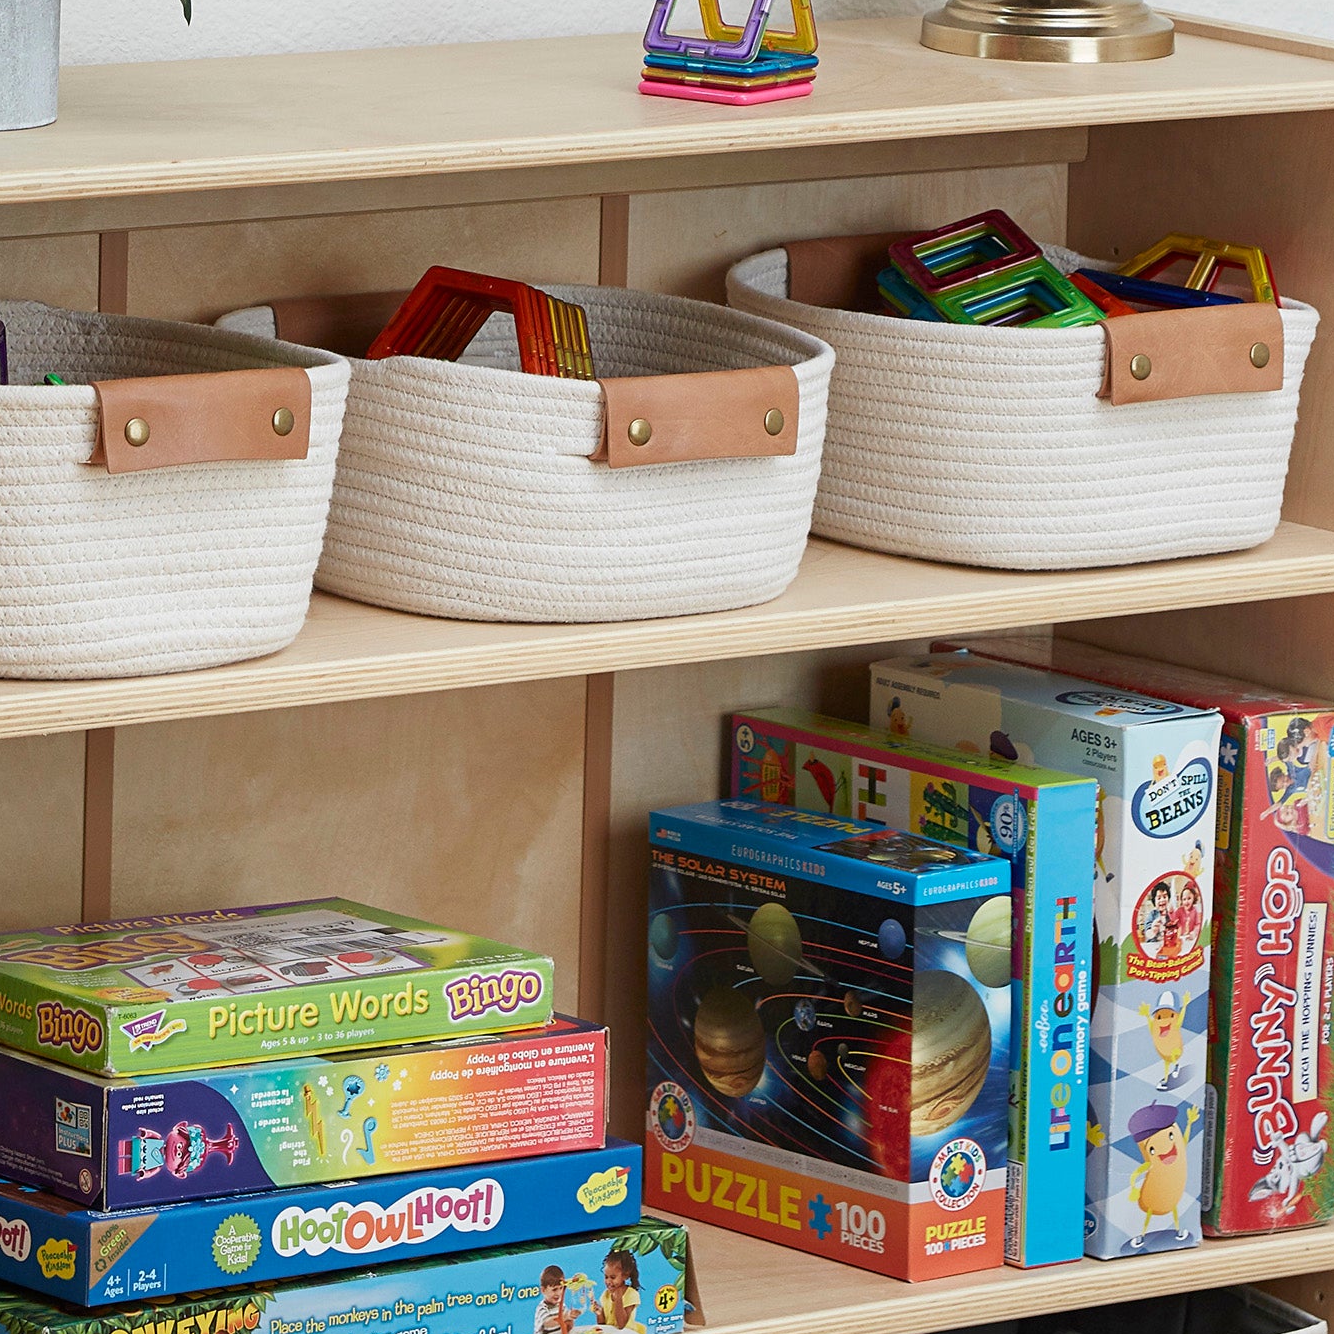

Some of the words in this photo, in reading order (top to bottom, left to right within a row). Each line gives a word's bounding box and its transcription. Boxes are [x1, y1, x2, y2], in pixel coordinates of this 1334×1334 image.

[740, 730, 751, 750] 5+
[1071, 728, 1101, 746] AGES
[1104, 736, 1117, 749] 3+
[1086, 748, 1091, 756] 2
[1092, 749, 1117, 762] Players
[1149, 778, 1177, 802] DON'T
[1181, 774, 1208, 786] SPILL
[1178, 788, 1191, 797] THE
[1145, 789, 1204, 831] BEANS
[1221, 787, 1230, 833] Insights
[1028, 807, 1036, 830] Erde
[652, 849, 674, 865] THE
[677, 856, 725, 878] SOLAR
[729, 868, 786, 892] SYSTEM
[877, 880, 892, 890] AGES
[892, 881, 907, 895] 5+
[1257, 846, 1299, 956] HOP
[54, 919, 152, 936] Picture
[153, 911, 244, 927] Words
[858, 939, 878, 949] NEPTUNE
[1305, 910, 1318, 968] BUNNIES!
[1128, 955, 1144, 967] The
[1146, 948, 1203, 969] Bean-Balancing
[210, 965, 247, 974] bicycle
[1129, 967, 1180, 980] Pot-Tipping
[1324, 956, 1334, 992] PLAYERS
[447, 972, 540, 1017] Bingo
[1077, 969, 1089, 1011] game
[1302, 971, 1312, 1026] HOPPING
[209, 1002, 320, 1040] Picture
[330, 981, 429, 1025] Words
[1323, 992, 1332, 1021] 2-4
[862, 1010, 878, 1019] MARS
[37, 1002, 102, 1052] Bingo
[816, 1020, 834, 1028] EARTH
[260, 1039, 281, 1050] Ages
[282, 1037, 288, 1046] 5
[289, 1036, 296, 1045] &
[297, 1037, 309, 1048] up
[317, 1033, 323, 1042] 3
[324, 1032, 333, 1041] to
[335, 1030, 346, 1040] 36
[346, 1027, 375, 1040] players
[1301, 1028, 1310, 1053] THE
[1321, 1023, 1331, 1045] FOR
[541, 1048, 553, 1056] en
[554, 1042, 595, 1055] Aventura
[1075, 1015, 1089, 1075] memory
[466, 1053, 496, 1066] Poppy
[498, 1054, 510, 1064] de
[512, 1049, 539, 1060] Globo
[548, 1054, 594, 1066] L'aventure
[475, 1061, 533, 1075] montgolfière
[534, 1060, 546, 1069] en
[1247, 978, 1299, 1151] BUNNY
[430, 1070, 459, 1082] Poppy
[461, 1070, 474, 1079] de
[1301, 1056, 1310, 1093] CATCH
[251, 1090, 280, 1101] cuerda!
[282, 1089, 289, 1097] la
[527, 1091, 542, 1100] LEGO
[653, 1082, 676, 1104] SMART
[676, 1088, 692, 1114] KIDS
[251, 1095, 294, 1108] ¡Encuentra
[147, 1107, 164, 1115] actual
[514, 1107, 529, 1116] LEGO
[258, 1119, 280, 1127] corde
[271, 1125, 298, 1133] Trouve
[58, 1135, 77, 1149] PLUS
[653, 1122, 692, 1153] COLLECTION
[279, 1141, 305, 1151] string!
[293, 1149, 307, 1157] the
[292, 1157, 311, 1167] Find
[934, 1140, 965, 1170] SMART
[964, 1141, 984, 1164] KIDS
[582, 1177, 624, 1199] Peaceable
[934, 1182, 980, 1209] COLLECTION
[588, 1187, 622, 1208] Kingdom
[661, 1153, 802, 1231] PUZZLE
[835, 1201, 886, 1242] 100
[98, 1223, 120, 1246] 100%
[229, 1225, 236, 1236] A
[925, 1216, 987, 1243] PUZZLE
[99, 1229, 127, 1257] Green
[215, 1233, 259, 1247] Cooperative
[840, 1230, 885, 1255] PIECES
[924, 1242, 944, 1256] 100
[950, 1233, 986, 1251] PIECES
[41, 1247, 74, 1262] Peaceable
[219, 1243, 243, 1256] Game
[44, 1258, 71, 1273] Kingdom
[226, 1252, 248, 1266] Kids!
[106, 1274, 122, 1287] 4+
[138, 1268, 157, 1282] 2-4
[104, 1285, 124, 1298] Ages
[133, 1280, 162, 1293] Players
[305, 1317, 326, 1334] the
[328, 1308, 379, 1328] monkeys
[381, 1308, 392, 1322] in
[394, 1300, 415, 1317] the
[417, 1299, 445, 1321] palm
[447, 1293, 473, 1307] tree
[475, 1293, 498, 1306] one
[500, 1283, 515, 1301] by
[517, 1286, 540, 1299] one
[658, 1293, 675, 1310] 4+
[655, 1323, 676, 1334] players
